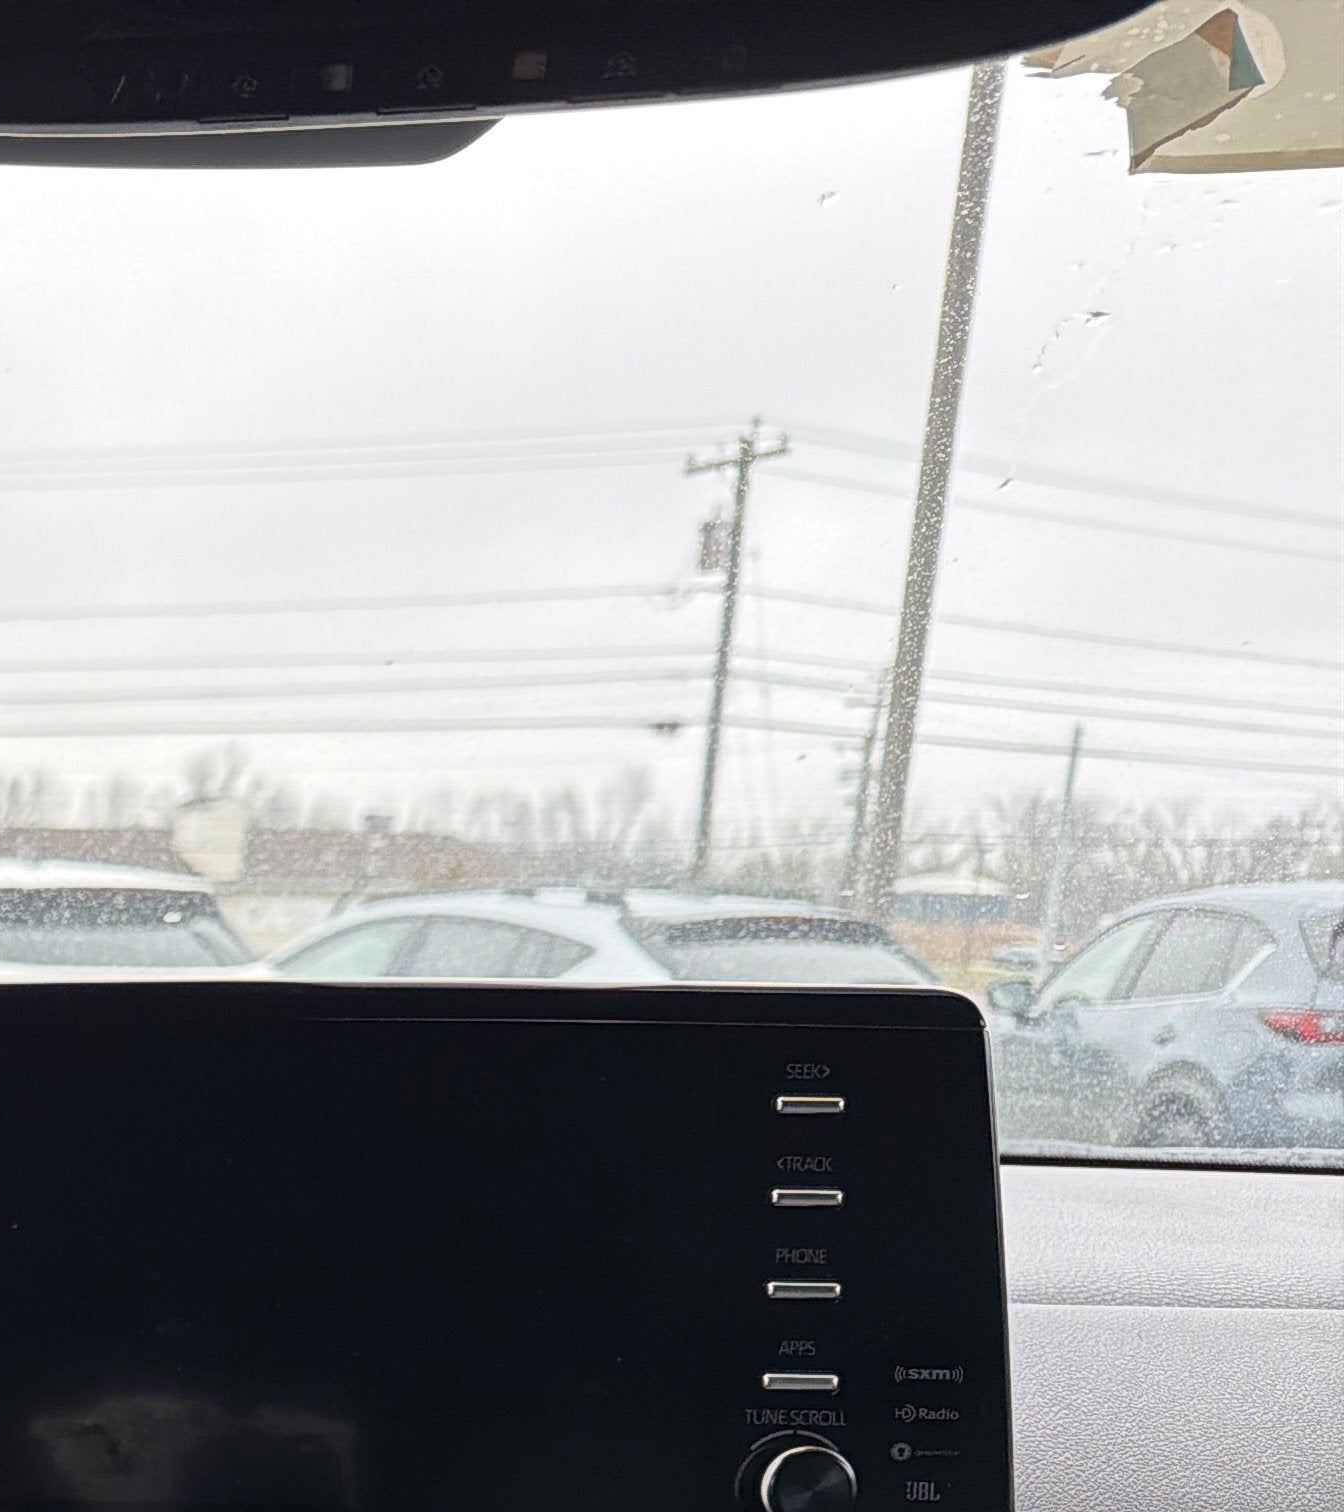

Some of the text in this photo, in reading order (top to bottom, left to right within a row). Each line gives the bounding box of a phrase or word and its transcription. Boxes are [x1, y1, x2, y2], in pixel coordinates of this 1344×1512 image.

[775, 1249, 827, 1264] PHONE
[778, 1340, 815, 1356] APPS
[745, 1408, 846, 1426] TUNE SCROLL
[918, 1409, 960, 1421] Radio
[906, 1481, 941, 1501] JBL
